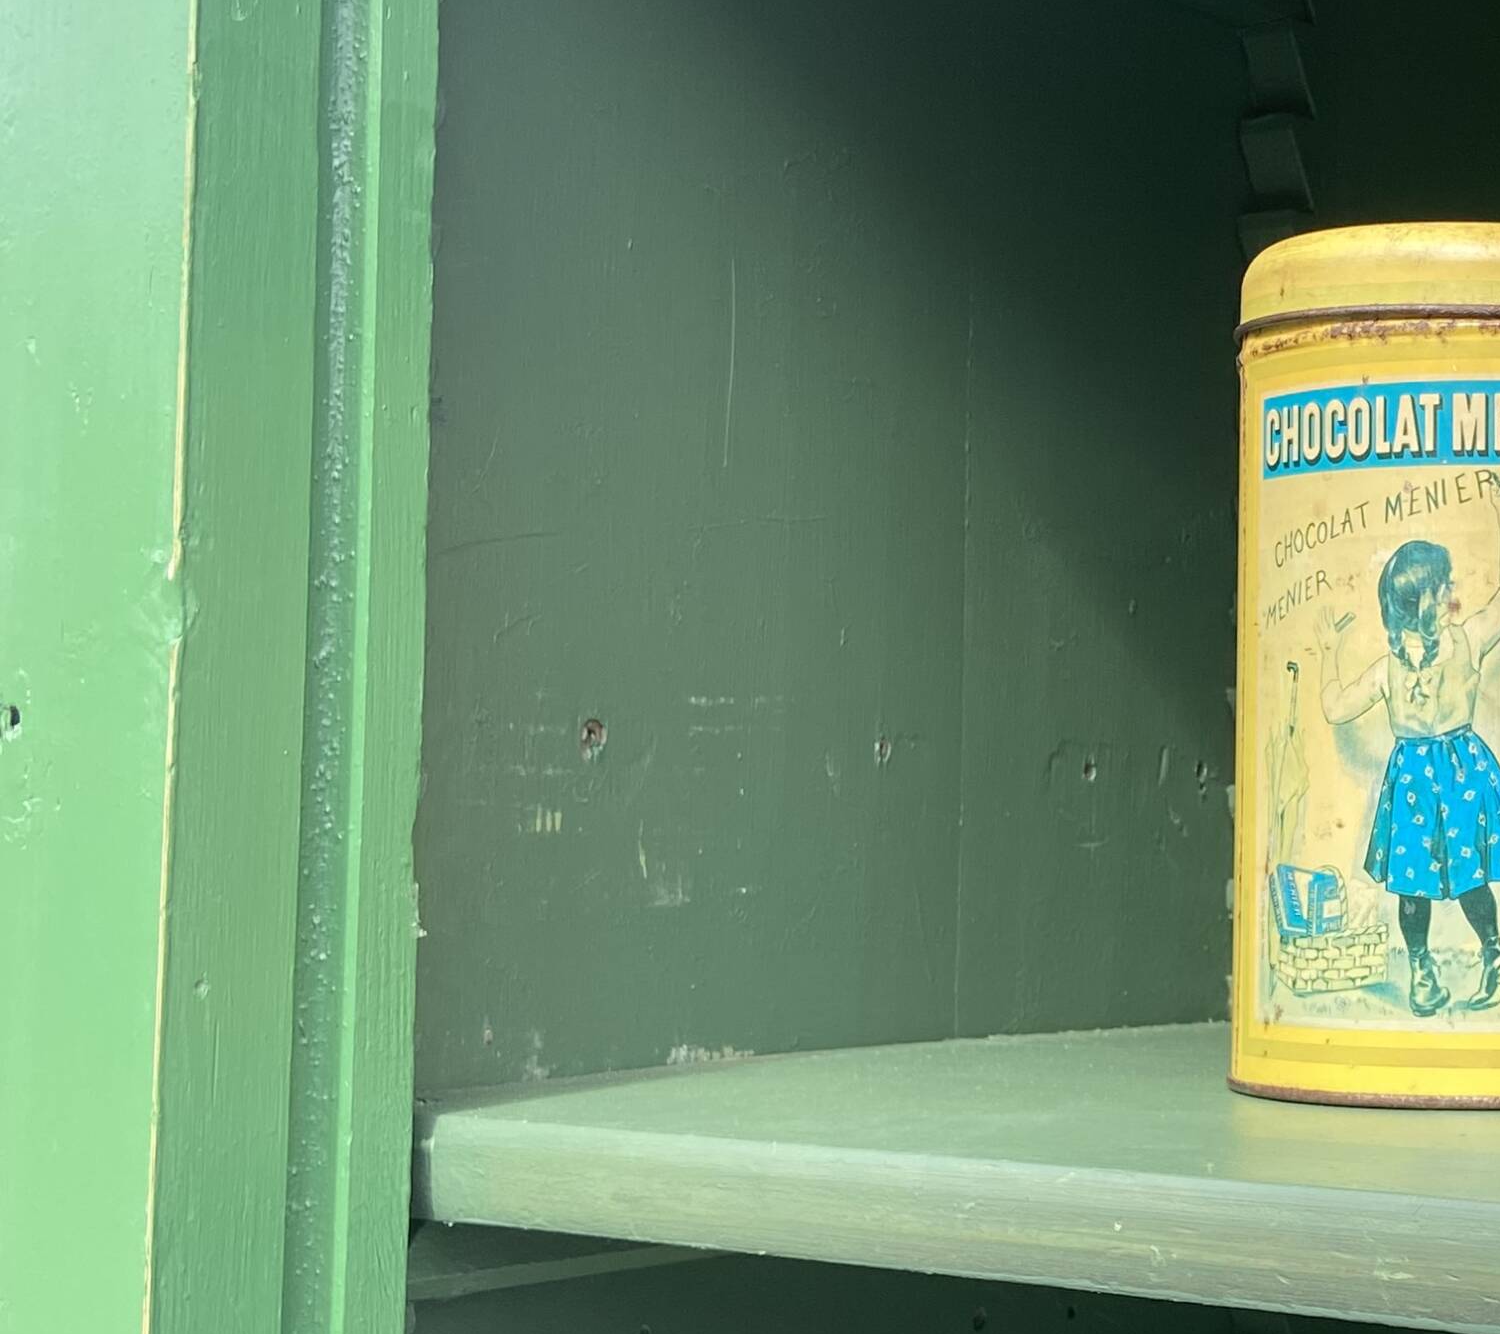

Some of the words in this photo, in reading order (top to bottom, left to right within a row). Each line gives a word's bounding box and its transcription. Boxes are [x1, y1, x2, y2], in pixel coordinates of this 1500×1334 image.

[1264, 393, 1443, 468] CHOCOLAT
[1274, 500, 1370, 568] CHOCOLAT
[1385, 468, 1494, 524] MENIER
[1265, 569, 1333, 629] MENIER
